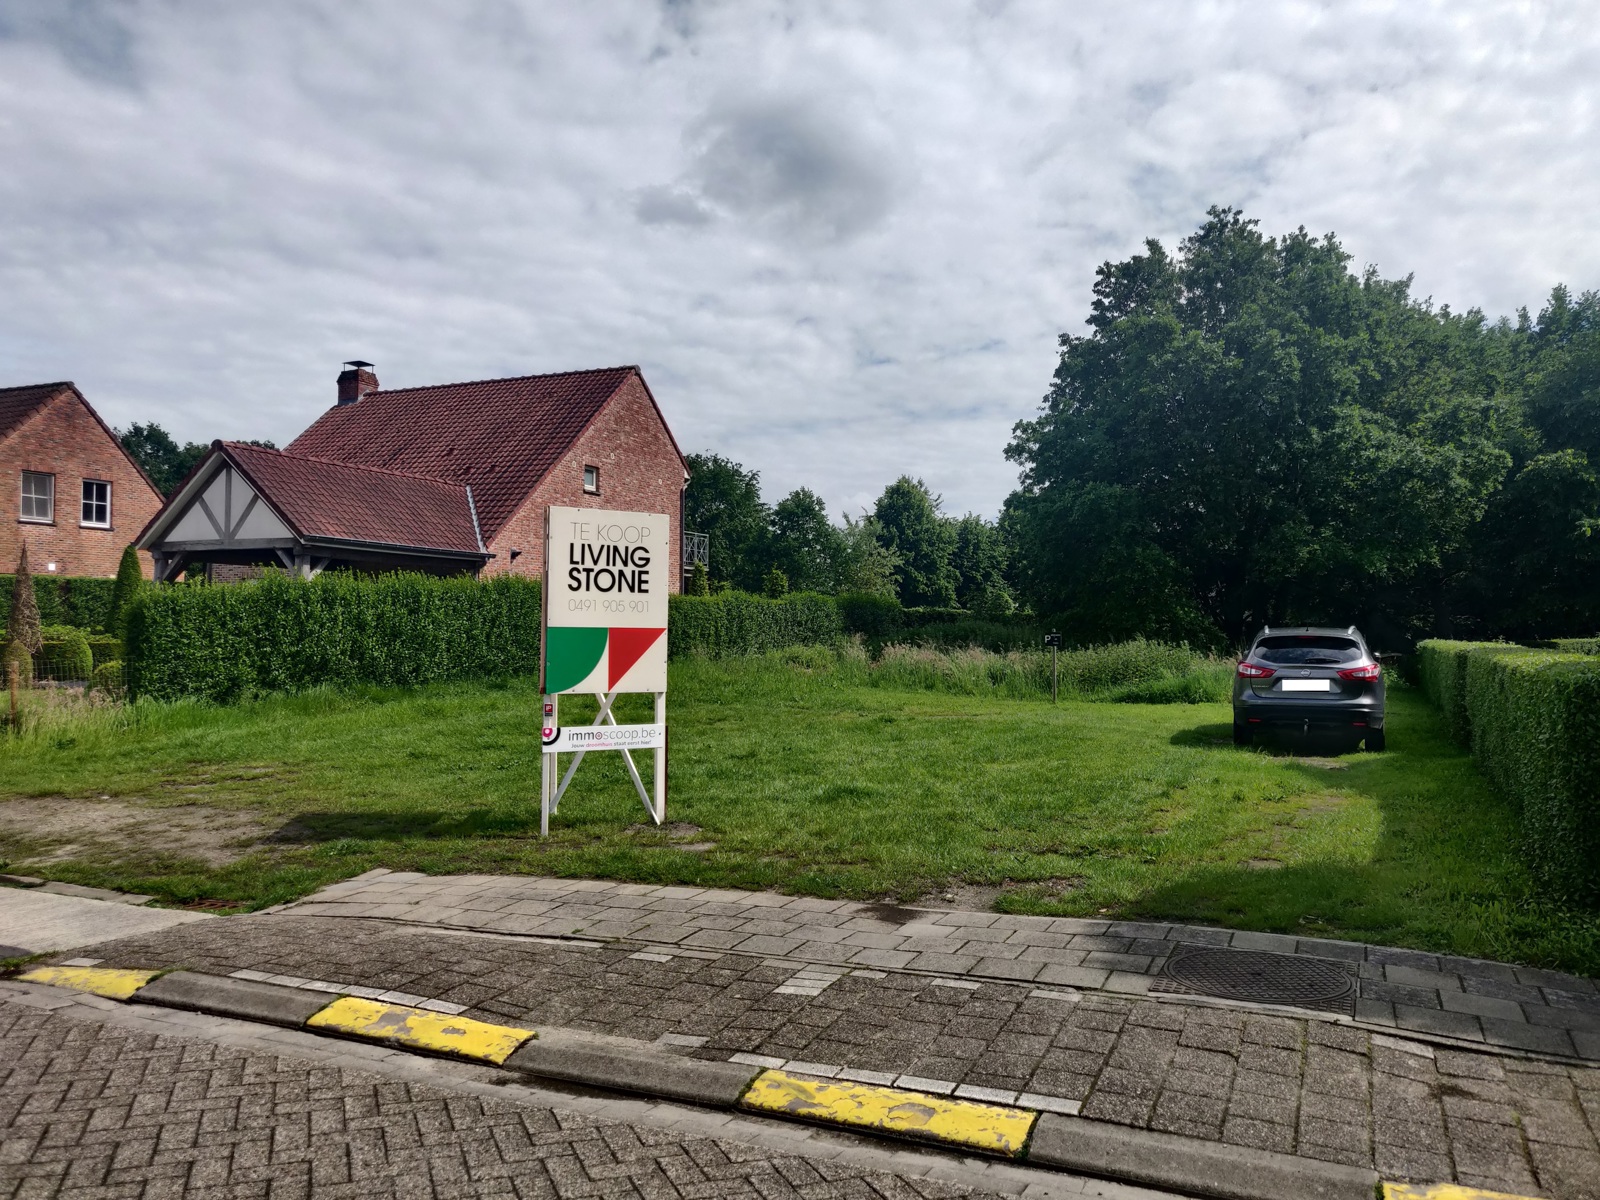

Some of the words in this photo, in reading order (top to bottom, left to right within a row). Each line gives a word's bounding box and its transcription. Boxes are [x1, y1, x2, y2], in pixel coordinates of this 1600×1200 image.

[570, 522, 590, 541] TE
[597, 524, 651, 543] KOOP
[570, 543, 651, 568] LIVING
[568, 567, 649, 593] STONE
[568, 599, 597, 611] 0491
[603, 600, 625, 612] 905
[629, 601, 649, 613] 901
